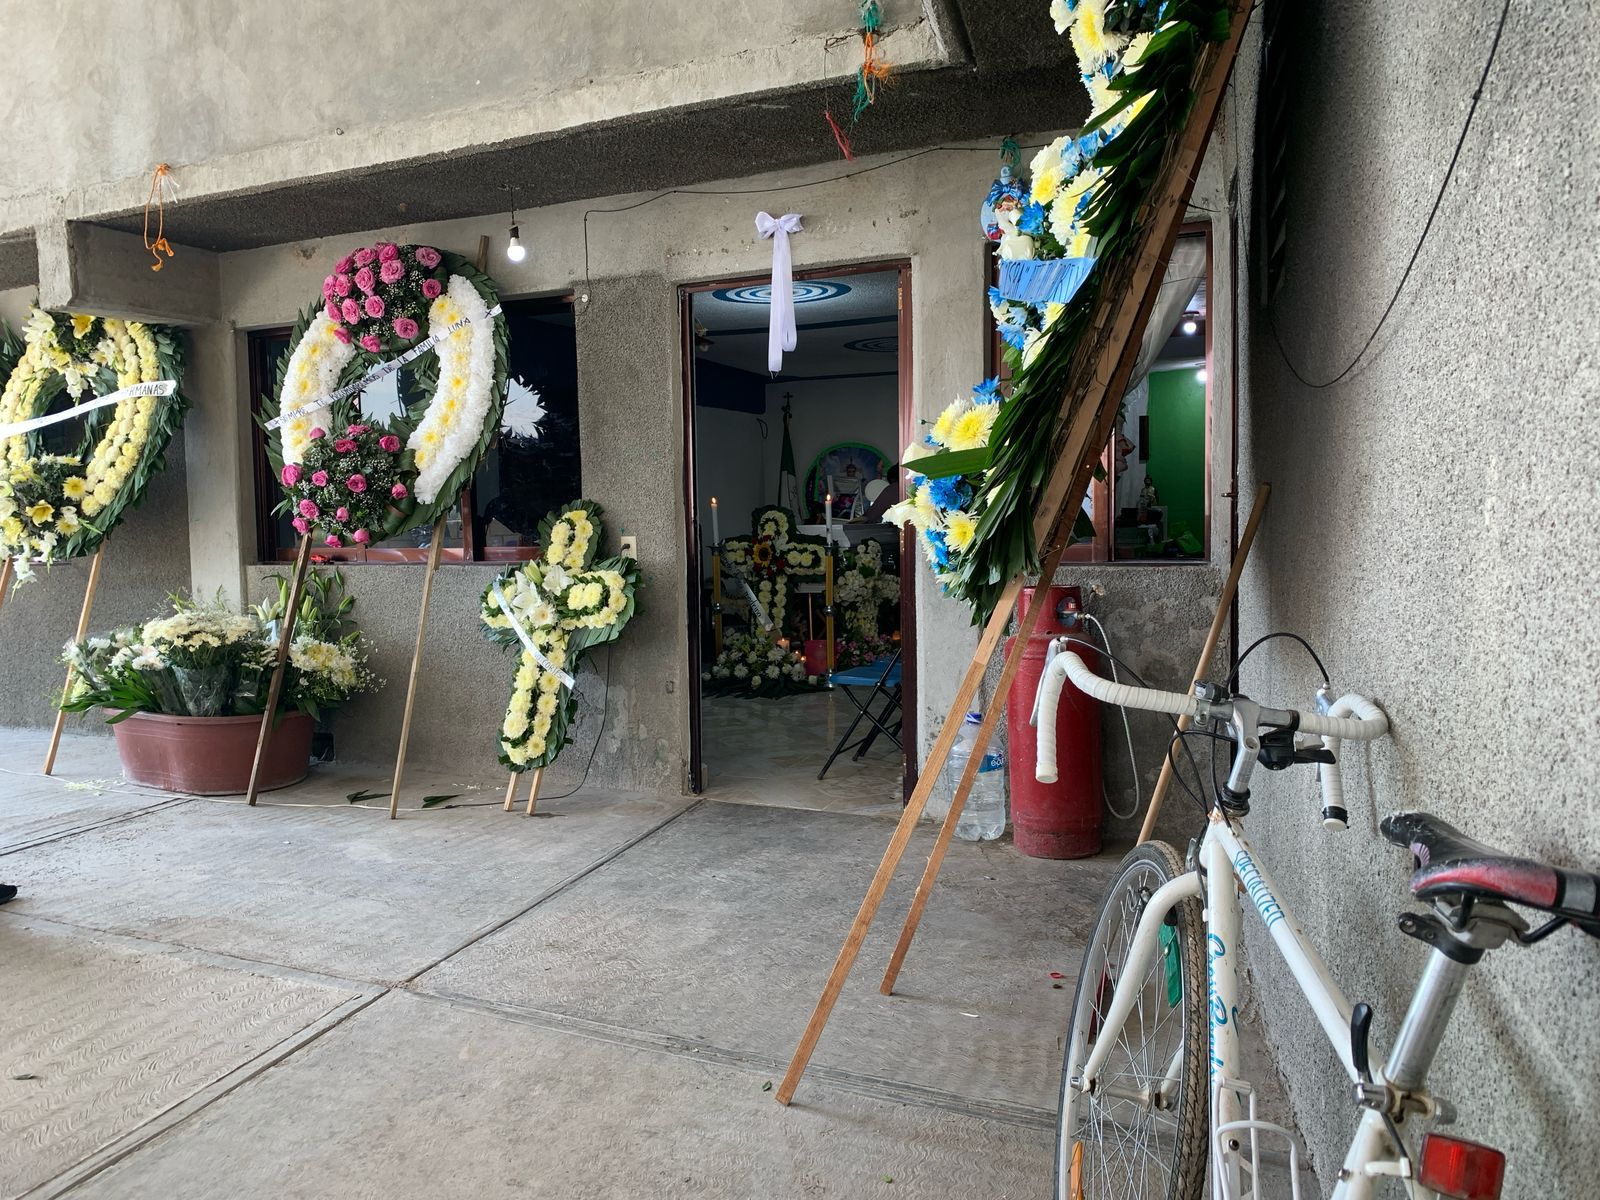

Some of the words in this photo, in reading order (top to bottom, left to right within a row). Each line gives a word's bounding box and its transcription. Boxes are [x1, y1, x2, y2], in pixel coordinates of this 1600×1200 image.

[382, 364, 396, 375] DE
[398, 355, 409, 365] LA
[413, 336, 441, 355] FAMILIA
[447, 318, 471, 334] LUNA
[122, 383, 165, 397] RMANAS
